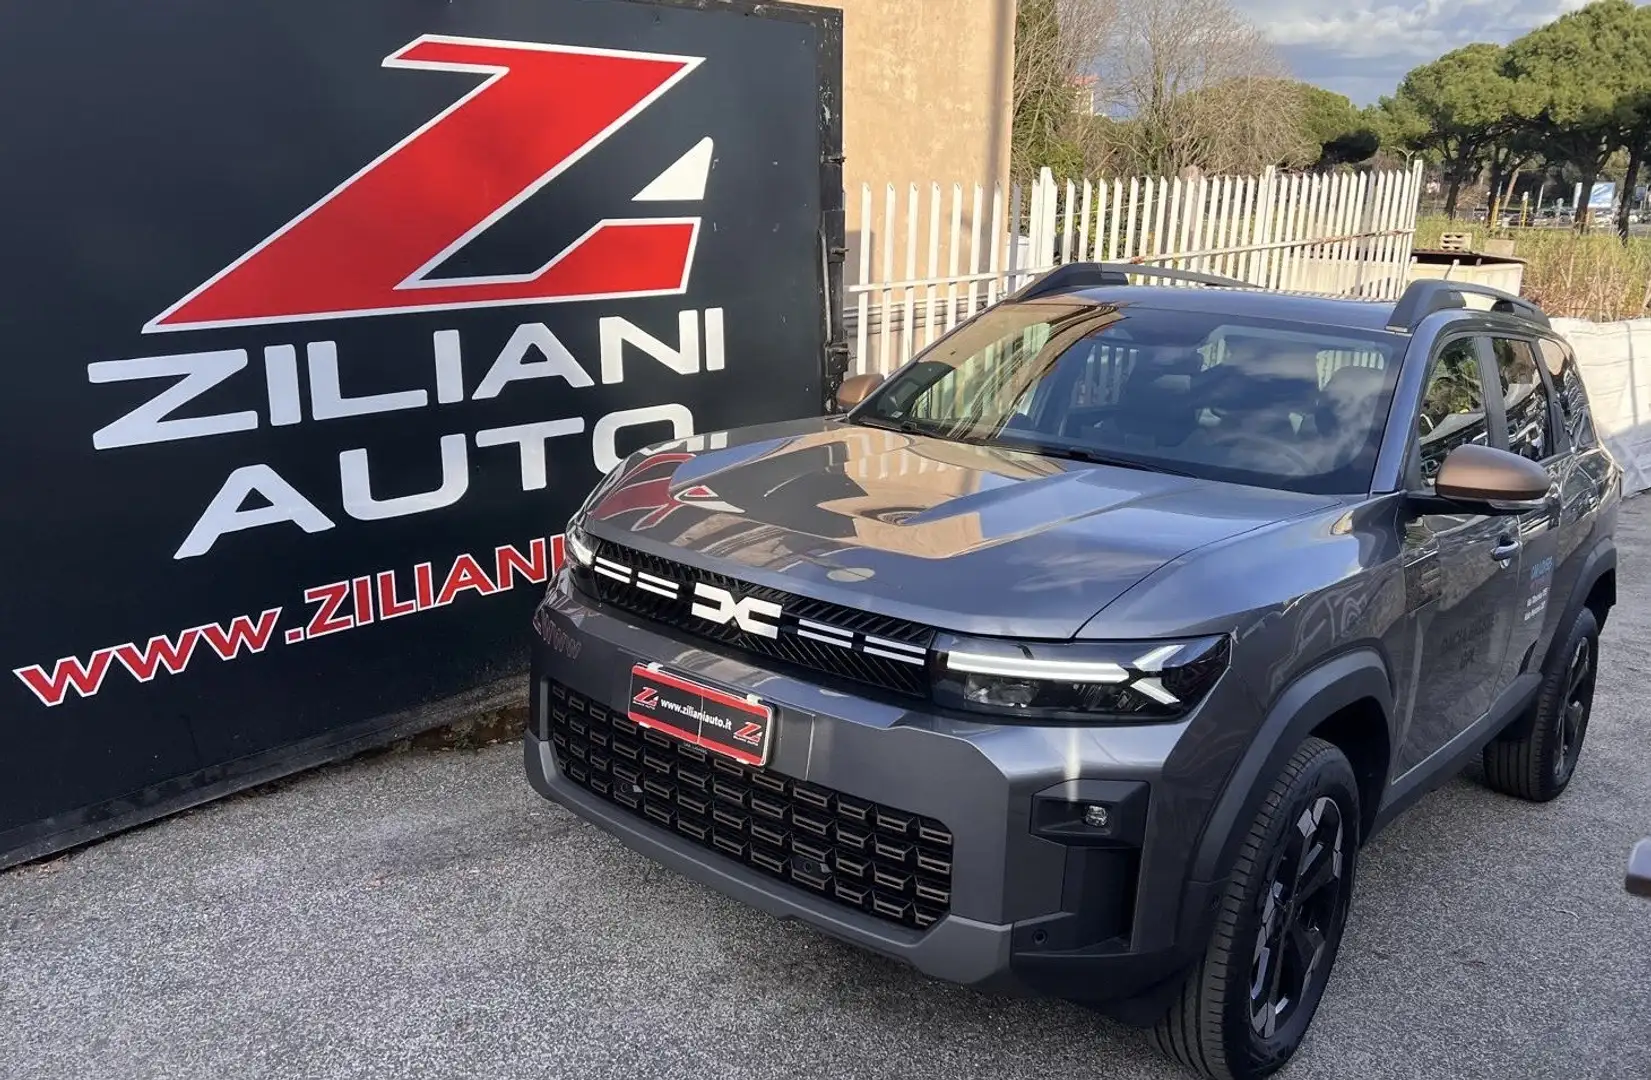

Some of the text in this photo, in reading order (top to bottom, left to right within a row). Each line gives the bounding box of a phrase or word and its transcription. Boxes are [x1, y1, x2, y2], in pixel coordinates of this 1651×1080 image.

[87, 307, 725, 450] ZILIANI
[173, 403, 695, 560] AUTO
[660, 698, 733, 731] www.zilianiauto.it
